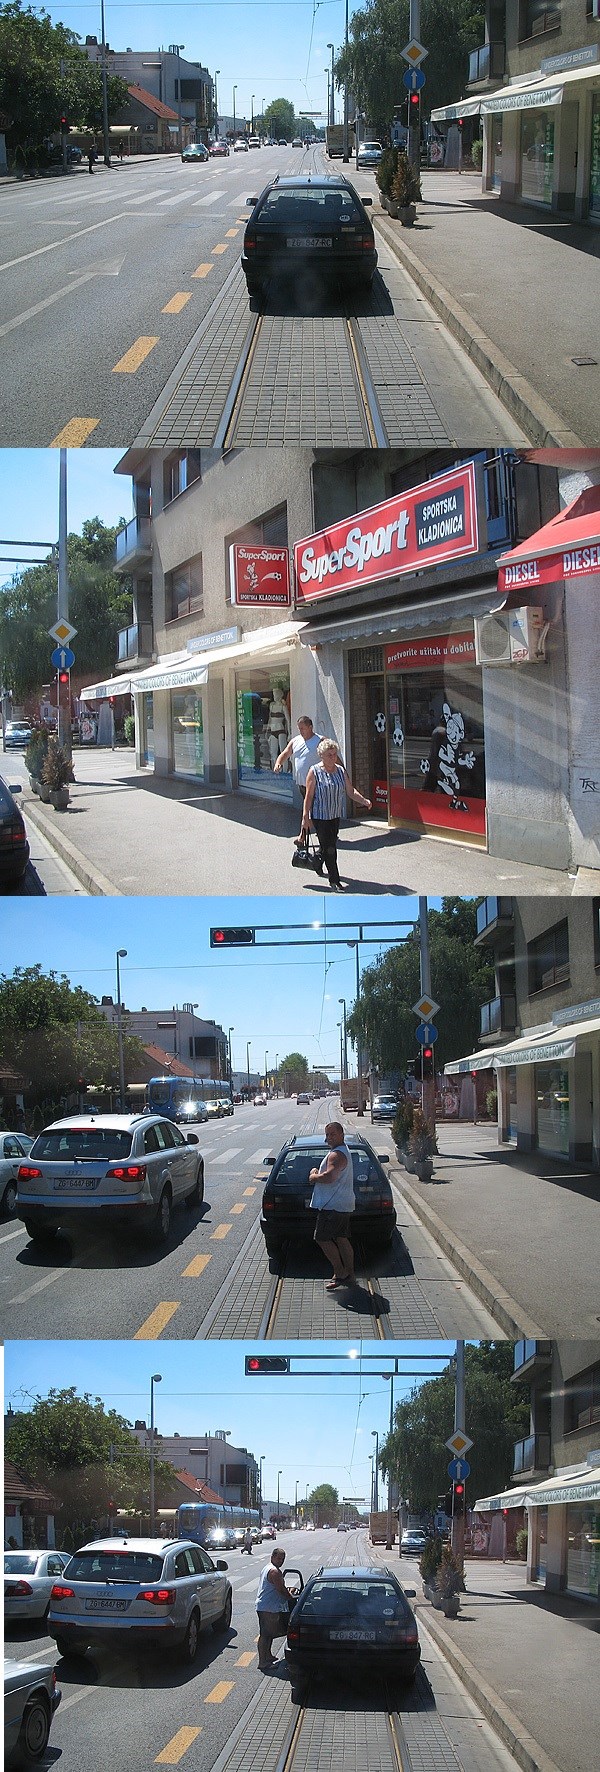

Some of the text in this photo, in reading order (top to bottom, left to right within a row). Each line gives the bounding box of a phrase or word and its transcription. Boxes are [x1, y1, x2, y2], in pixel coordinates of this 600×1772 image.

[500, 97, 516, 109] COLORS
[517, 96, 523, 107] OF
[524, 91, 551, 106] BENETTON
[422, 495, 457, 521] SPORTSKA
[418, 514, 463, 545] KLADIONICA
[238, 548, 285, 561] SuperSport
[300, 510, 409, 583] SuperSport
[505, 561, 540, 584] DIESEL
[259, 594, 287, 602] KLADIONICA
[388, 648, 417, 663] pretvorite
[420, 646, 441, 655] užitak
[450, 642, 475, 654] dobita
[149, 676, 164, 689] COLORS
[165, 675, 171, 687] OF
[172, 671, 197, 685] BENETTON
[513, 1050, 529, 1063] COLORS
[530, 1049, 536, 1060] OF
[537, 1043, 564, 1059] BENETTON
[545, 1489, 561, 1502] COLORS
[562, 1489, 568, 1500] OF
[569, 1485, 597, 1499] BENETTON
